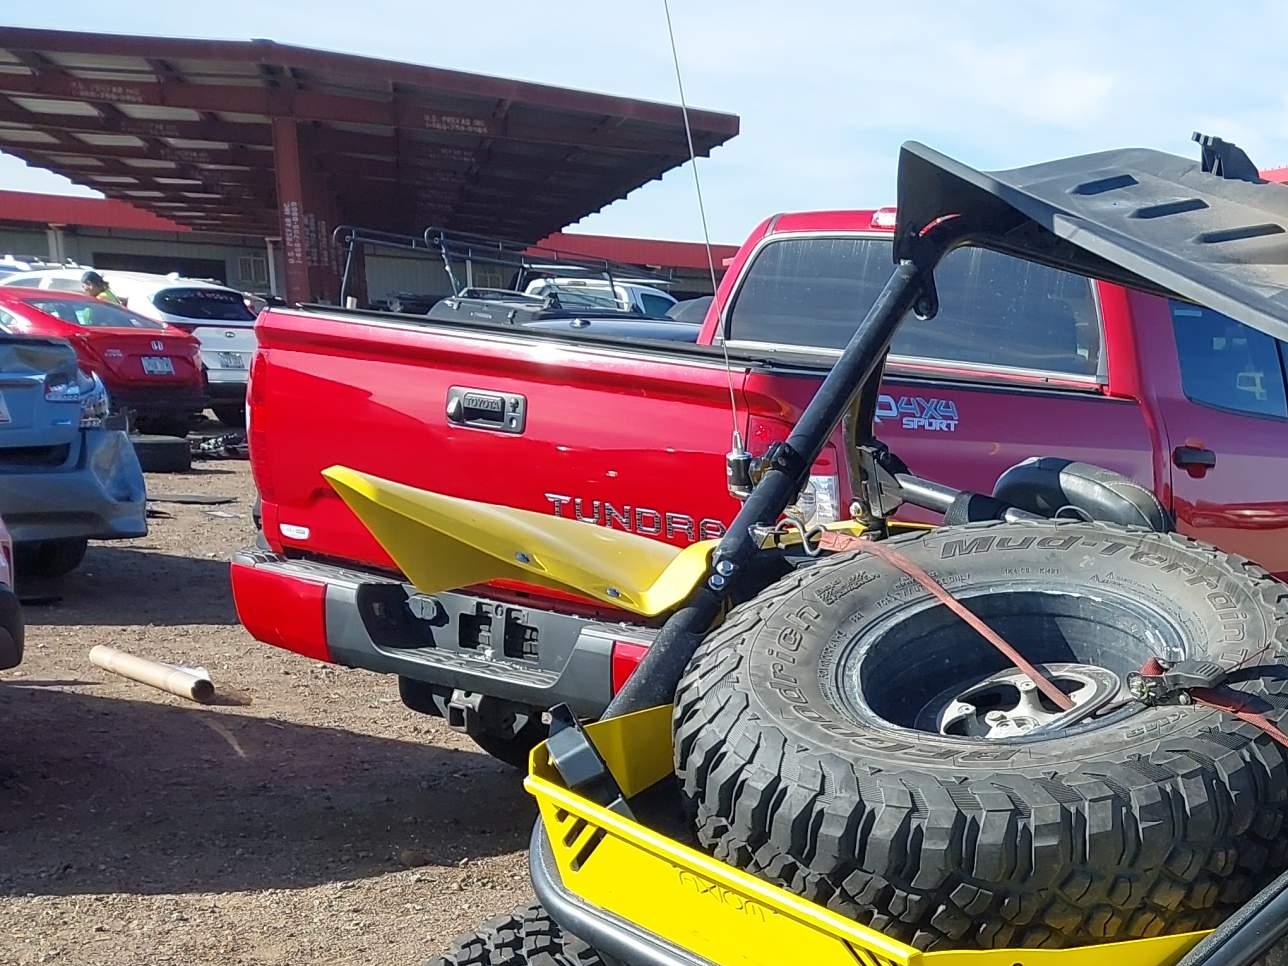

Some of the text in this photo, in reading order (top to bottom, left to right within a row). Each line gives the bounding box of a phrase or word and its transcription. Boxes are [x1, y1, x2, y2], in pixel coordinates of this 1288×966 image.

[466, 397, 501, 410] TOYOTA
[902, 416, 958, 432] SPORT
[544, 493, 728, 542] TUNDRA
